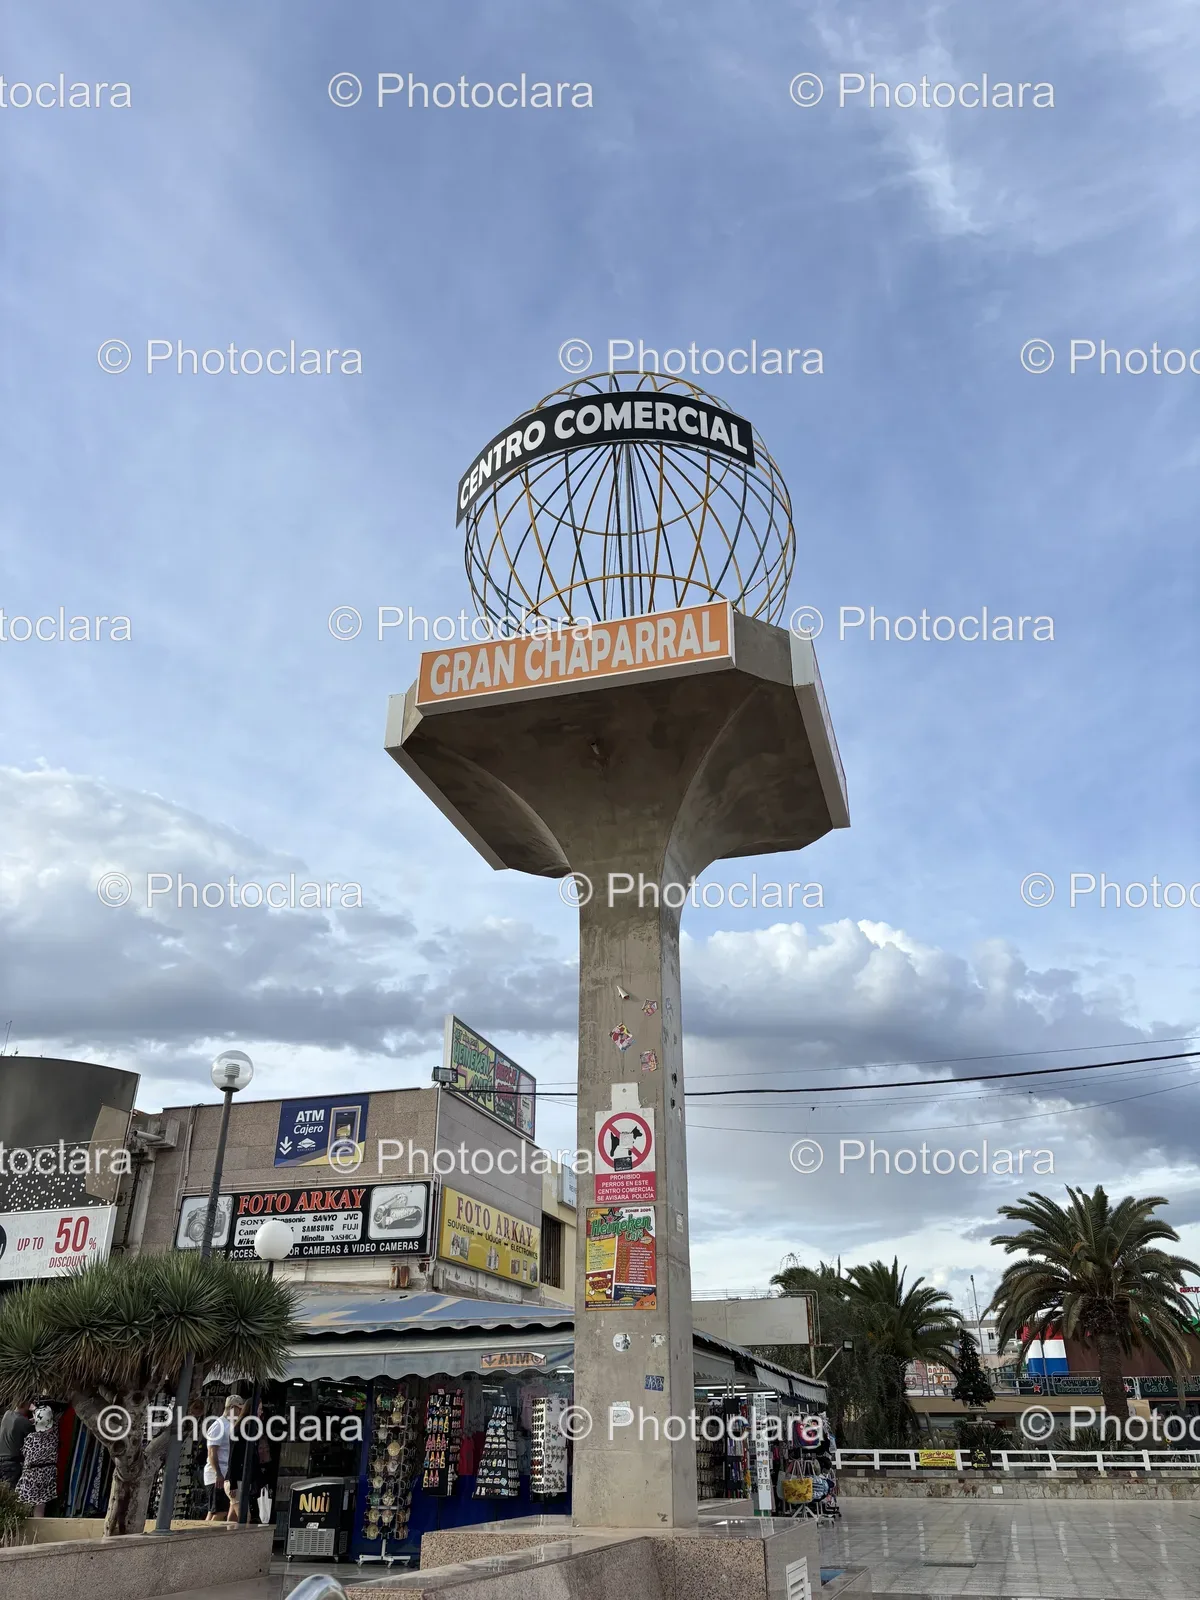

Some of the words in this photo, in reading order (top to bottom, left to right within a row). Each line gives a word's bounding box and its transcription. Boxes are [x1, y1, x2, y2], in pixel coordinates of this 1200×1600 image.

[459, 420, 546, 510] CENTRO
[554, 401, 748, 456] COMERCIAL
[430, 643, 516, 695] GRAN
[524, 610, 721, 681] CHAPARRAL
[295, 1109, 325, 1123] ATM
[293, 1124, 324, 1136] Cajero
[621, 1186, 655, 1194] COMERCIAL
[237, 1193, 292, 1215] FOTO
[294, 1188, 366, 1211] ARKAY
[240, 1218, 266, 1226] SONY
[312, 1214, 338, 1222] SANYO
[344, 1213, 359, 1221] JVC
[456, 1196, 491, 1231] FOTO
[495, 1213, 533, 1248] ARKAY
[591, 1213, 652, 1237] Heineken
[301, 1224, 334, 1233] SAMSUNG
[342, 1223, 359, 1231] FUJI
[16, 1237, 31, 1252] UP
[32, 1236, 44, 1250] TO
[301, 1234, 325, 1242] Minolta
[330, 1233, 358, 1241] YASHICA
[447, 1218, 475, 1236] SOUVENIR
[510, 1243, 538, 1260] ELECTRONICS
[303, 1243, 341, 1255] CAMERAS
[343, 1243, 349, 1253] &
[351, 1242, 376, 1253] VIDEO
[379, 1240, 419, 1252] CAMERAS
[48, 1254, 87, 1269] DISCOUNT
[498, 1353, 530, 1365] ATM
[298, 1491, 331, 1513] Nuii
